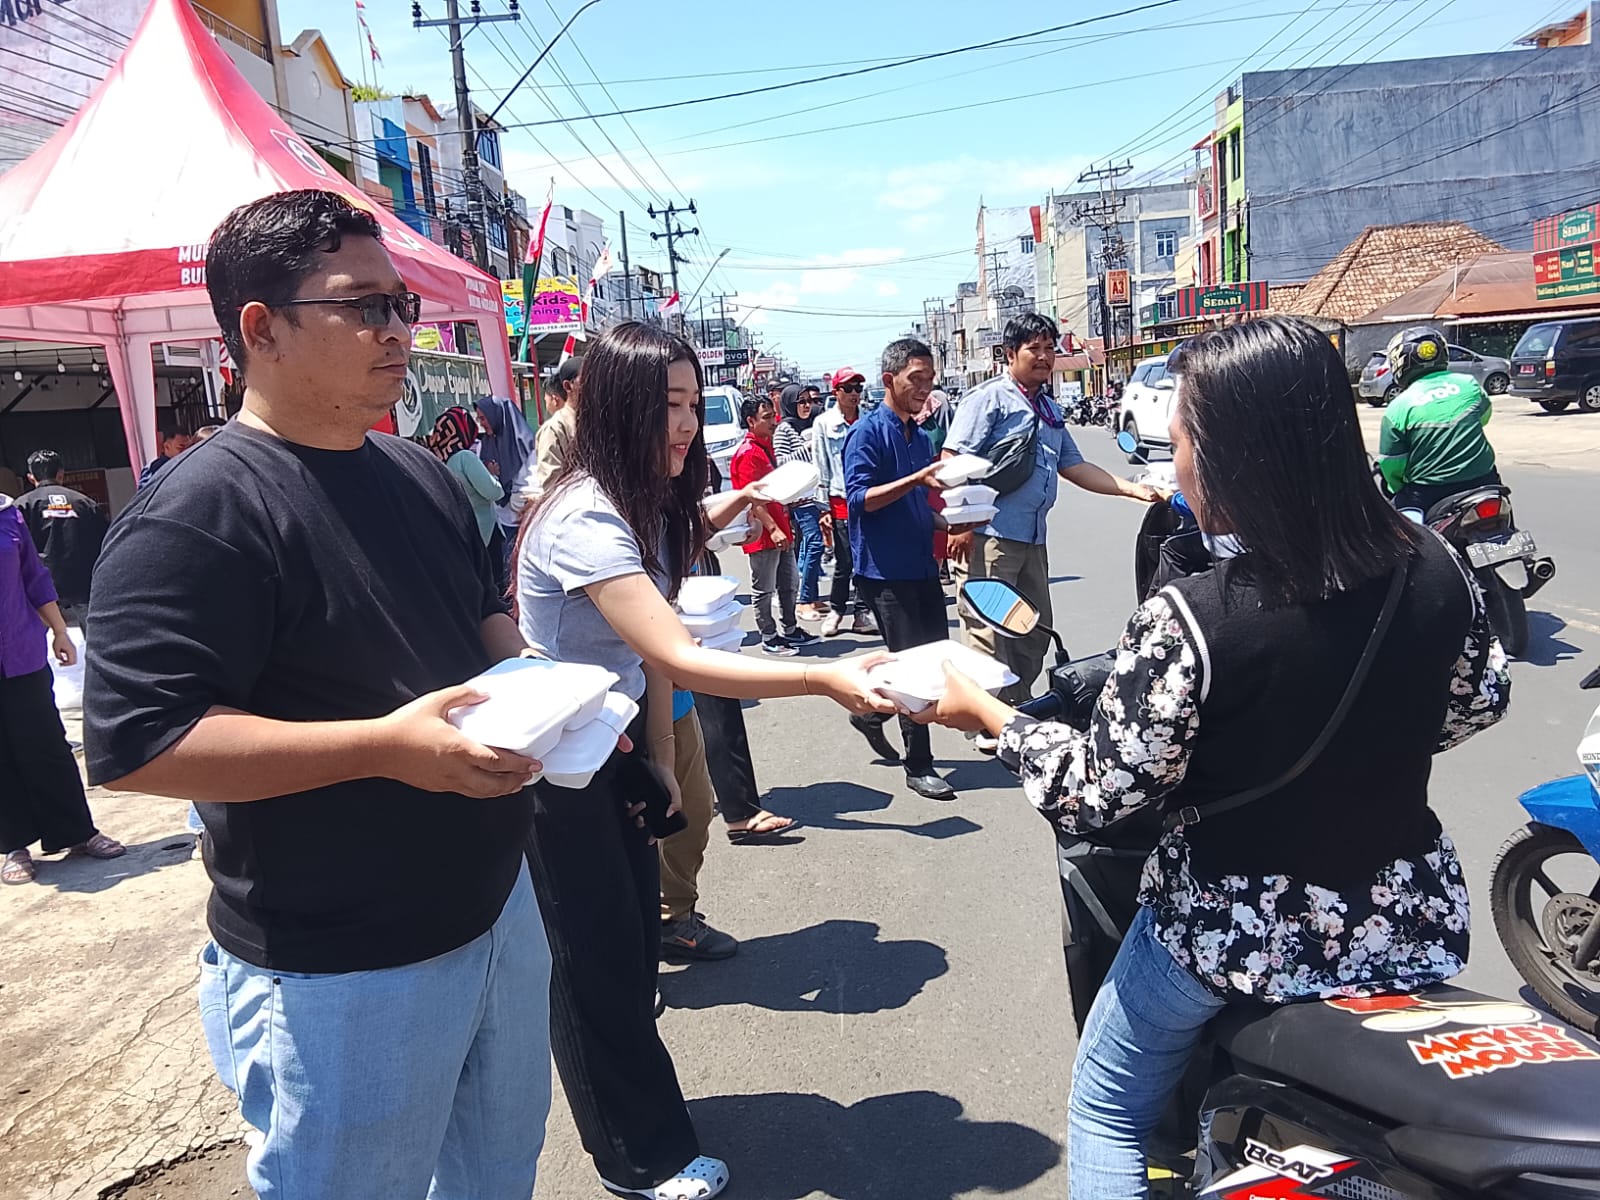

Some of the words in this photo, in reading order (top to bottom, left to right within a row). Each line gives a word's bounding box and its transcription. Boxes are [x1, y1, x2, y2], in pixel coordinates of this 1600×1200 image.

[533, 294, 569, 307] Kids
[1203, 296, 1242, 309] SEDARI
[505, 307, 560, 319] Lening
[697, 350, 723, 360] GOLDEN
[1414, 1022, 1566, 1061] MICKEY
[1443, 1041, 1597, 1076] MOUSE
